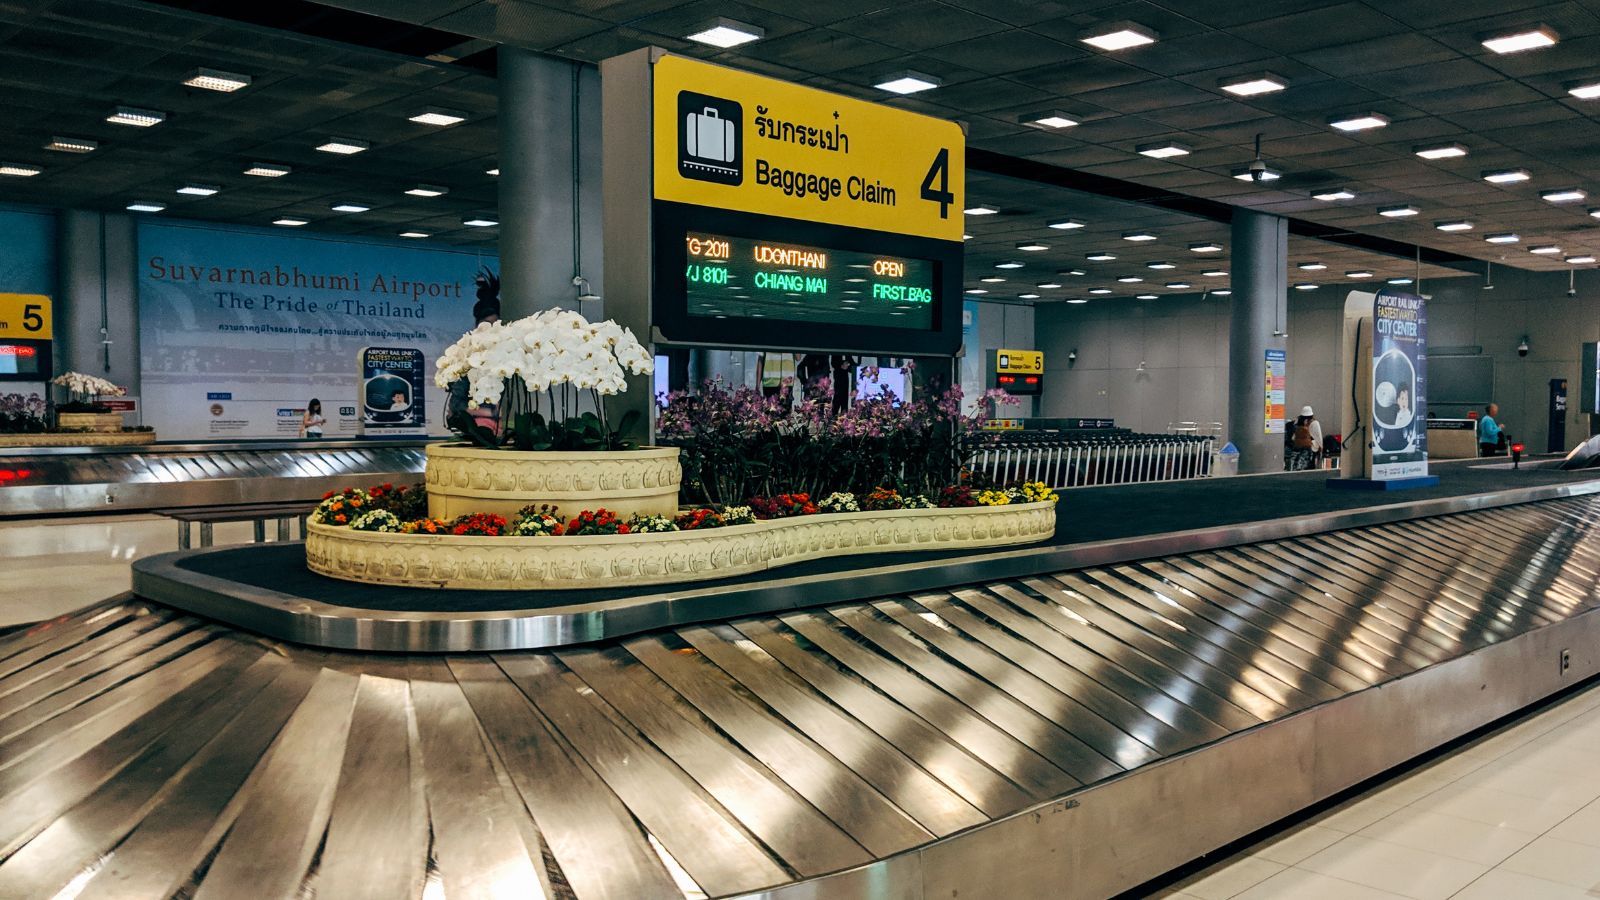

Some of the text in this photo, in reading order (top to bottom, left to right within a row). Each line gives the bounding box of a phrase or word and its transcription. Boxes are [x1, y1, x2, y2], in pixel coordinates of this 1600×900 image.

[754, 104, 849, 154] รับกระเป๋า
[755, 159, 896, 206] Baggage Claim
[920, 147, 954, 219] 4
[686, 236, 903, 278] G 2011 UDONTHANI OPEN
[149, 255, 462, 301] Suvarnabhumi Airport
[702, 266, 728, 285] 8101
[754, 271, 804, 292] CHIANG
[805, 276, 827, 294] MAI
[873, 283, 907, 300] FIRST
[908, 286, 932, 303] BAG
[213, 291, 426, 319] The Pride of Thailand
[1378, 295, 1398, 306] AIRPORT
[1398, 297, 1408, 308] RAIL
[1378, 306, 1400, 319] FASTEST
[22, 304, 43, 332] 5
[1377, 318, 1417, 336] CITY CENTER
[384, 361, 412, 369] CENTER
[1035, 356, 1041, 370] 5
